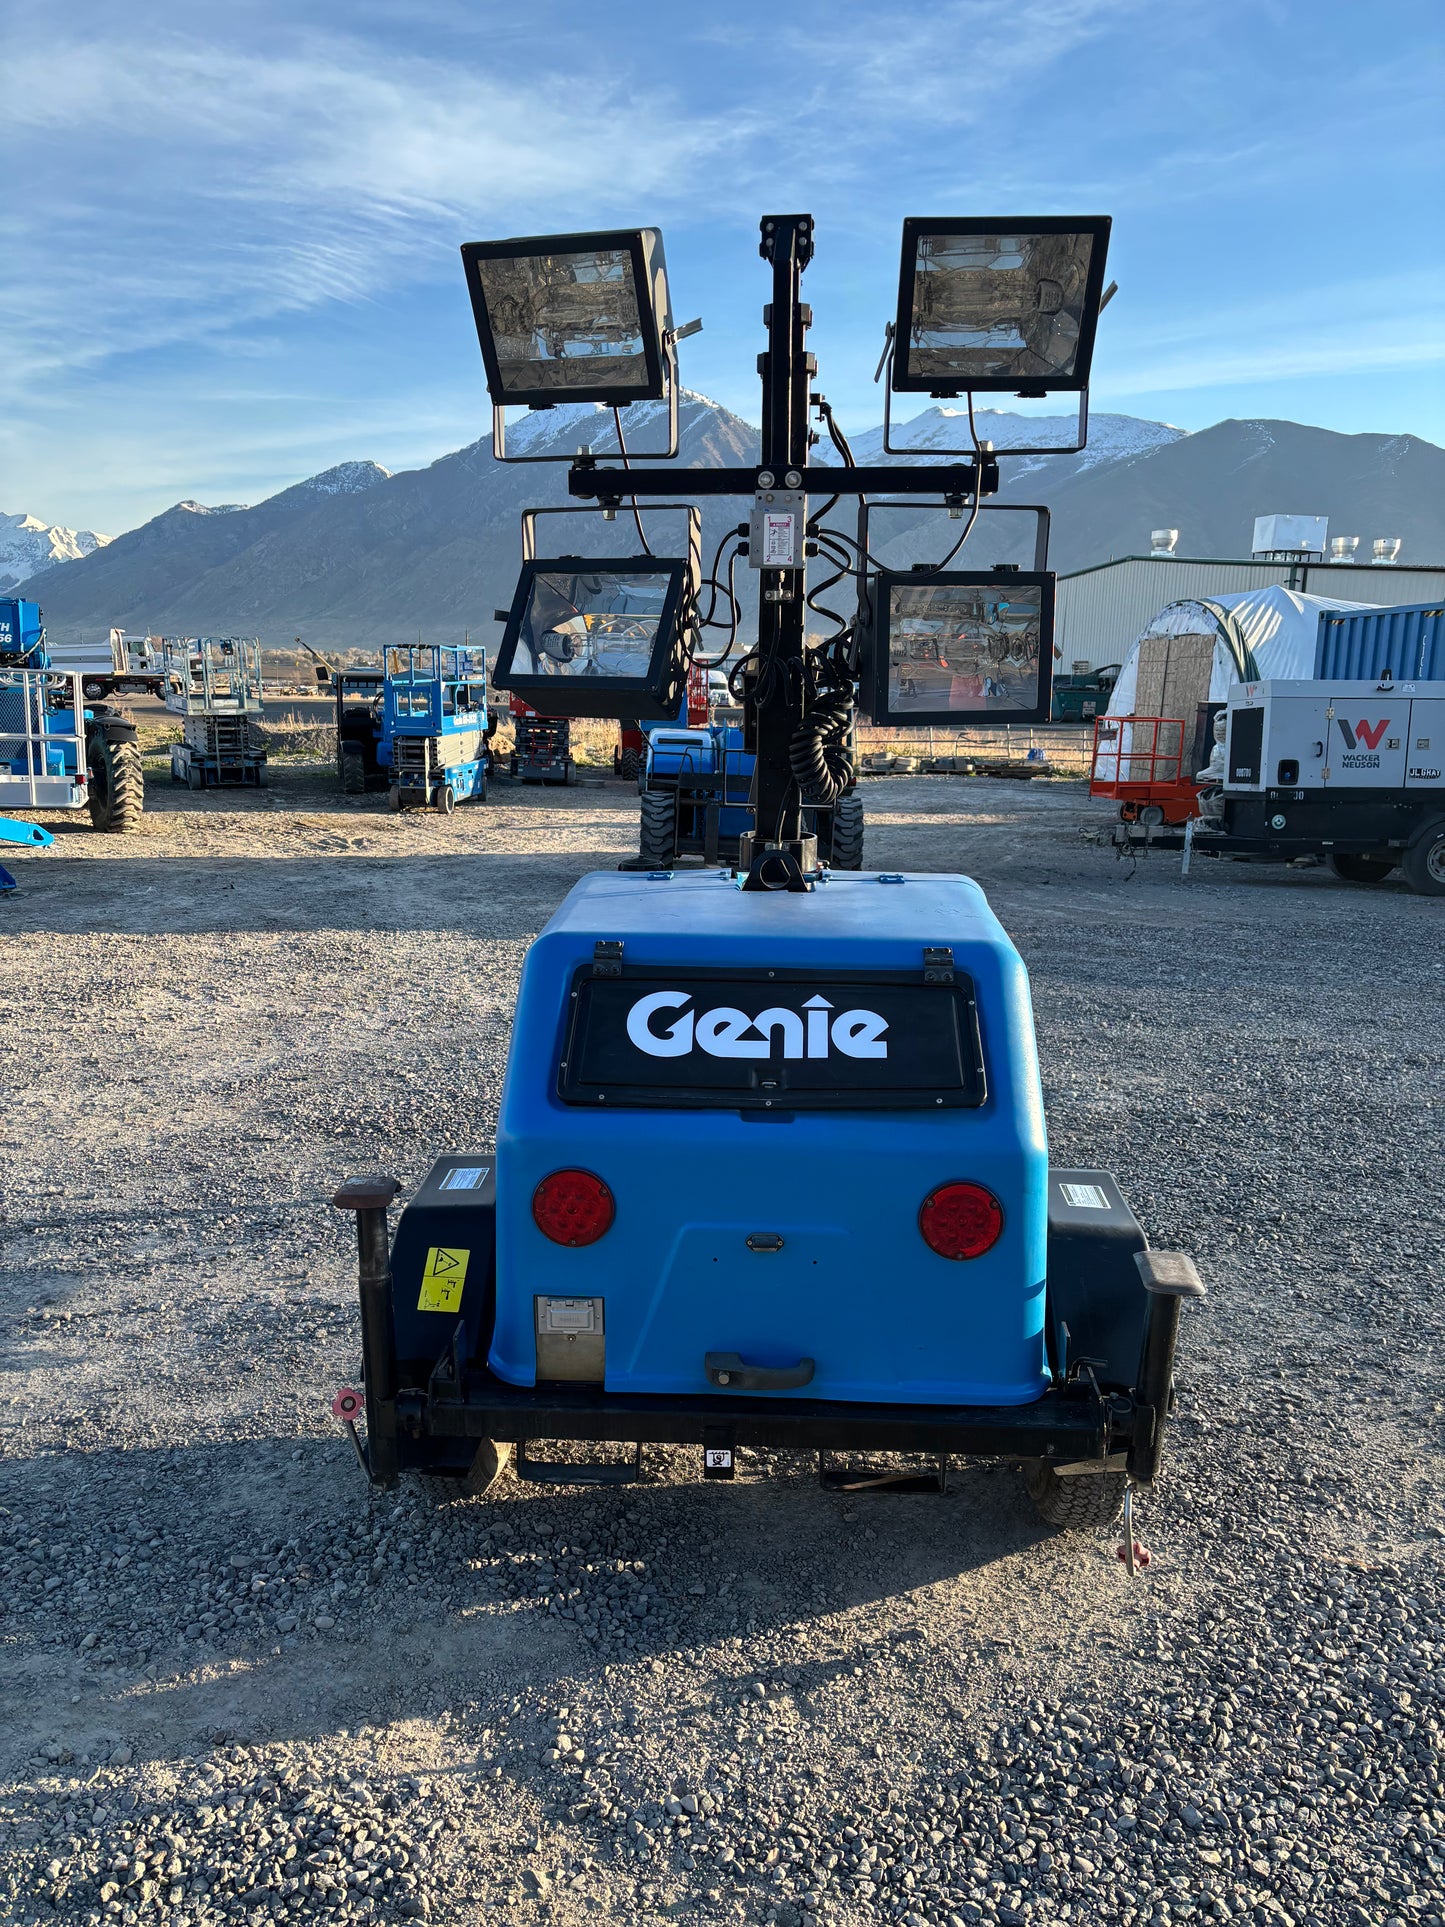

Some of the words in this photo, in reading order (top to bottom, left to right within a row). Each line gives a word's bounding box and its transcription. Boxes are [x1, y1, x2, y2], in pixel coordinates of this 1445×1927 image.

[0, 622, 10, 632] H
[1342, 754, 1380, 762] WACKER
[1342, 761, 1380, 769] NEUSON
[626, 990, 890, 1059] Genie
